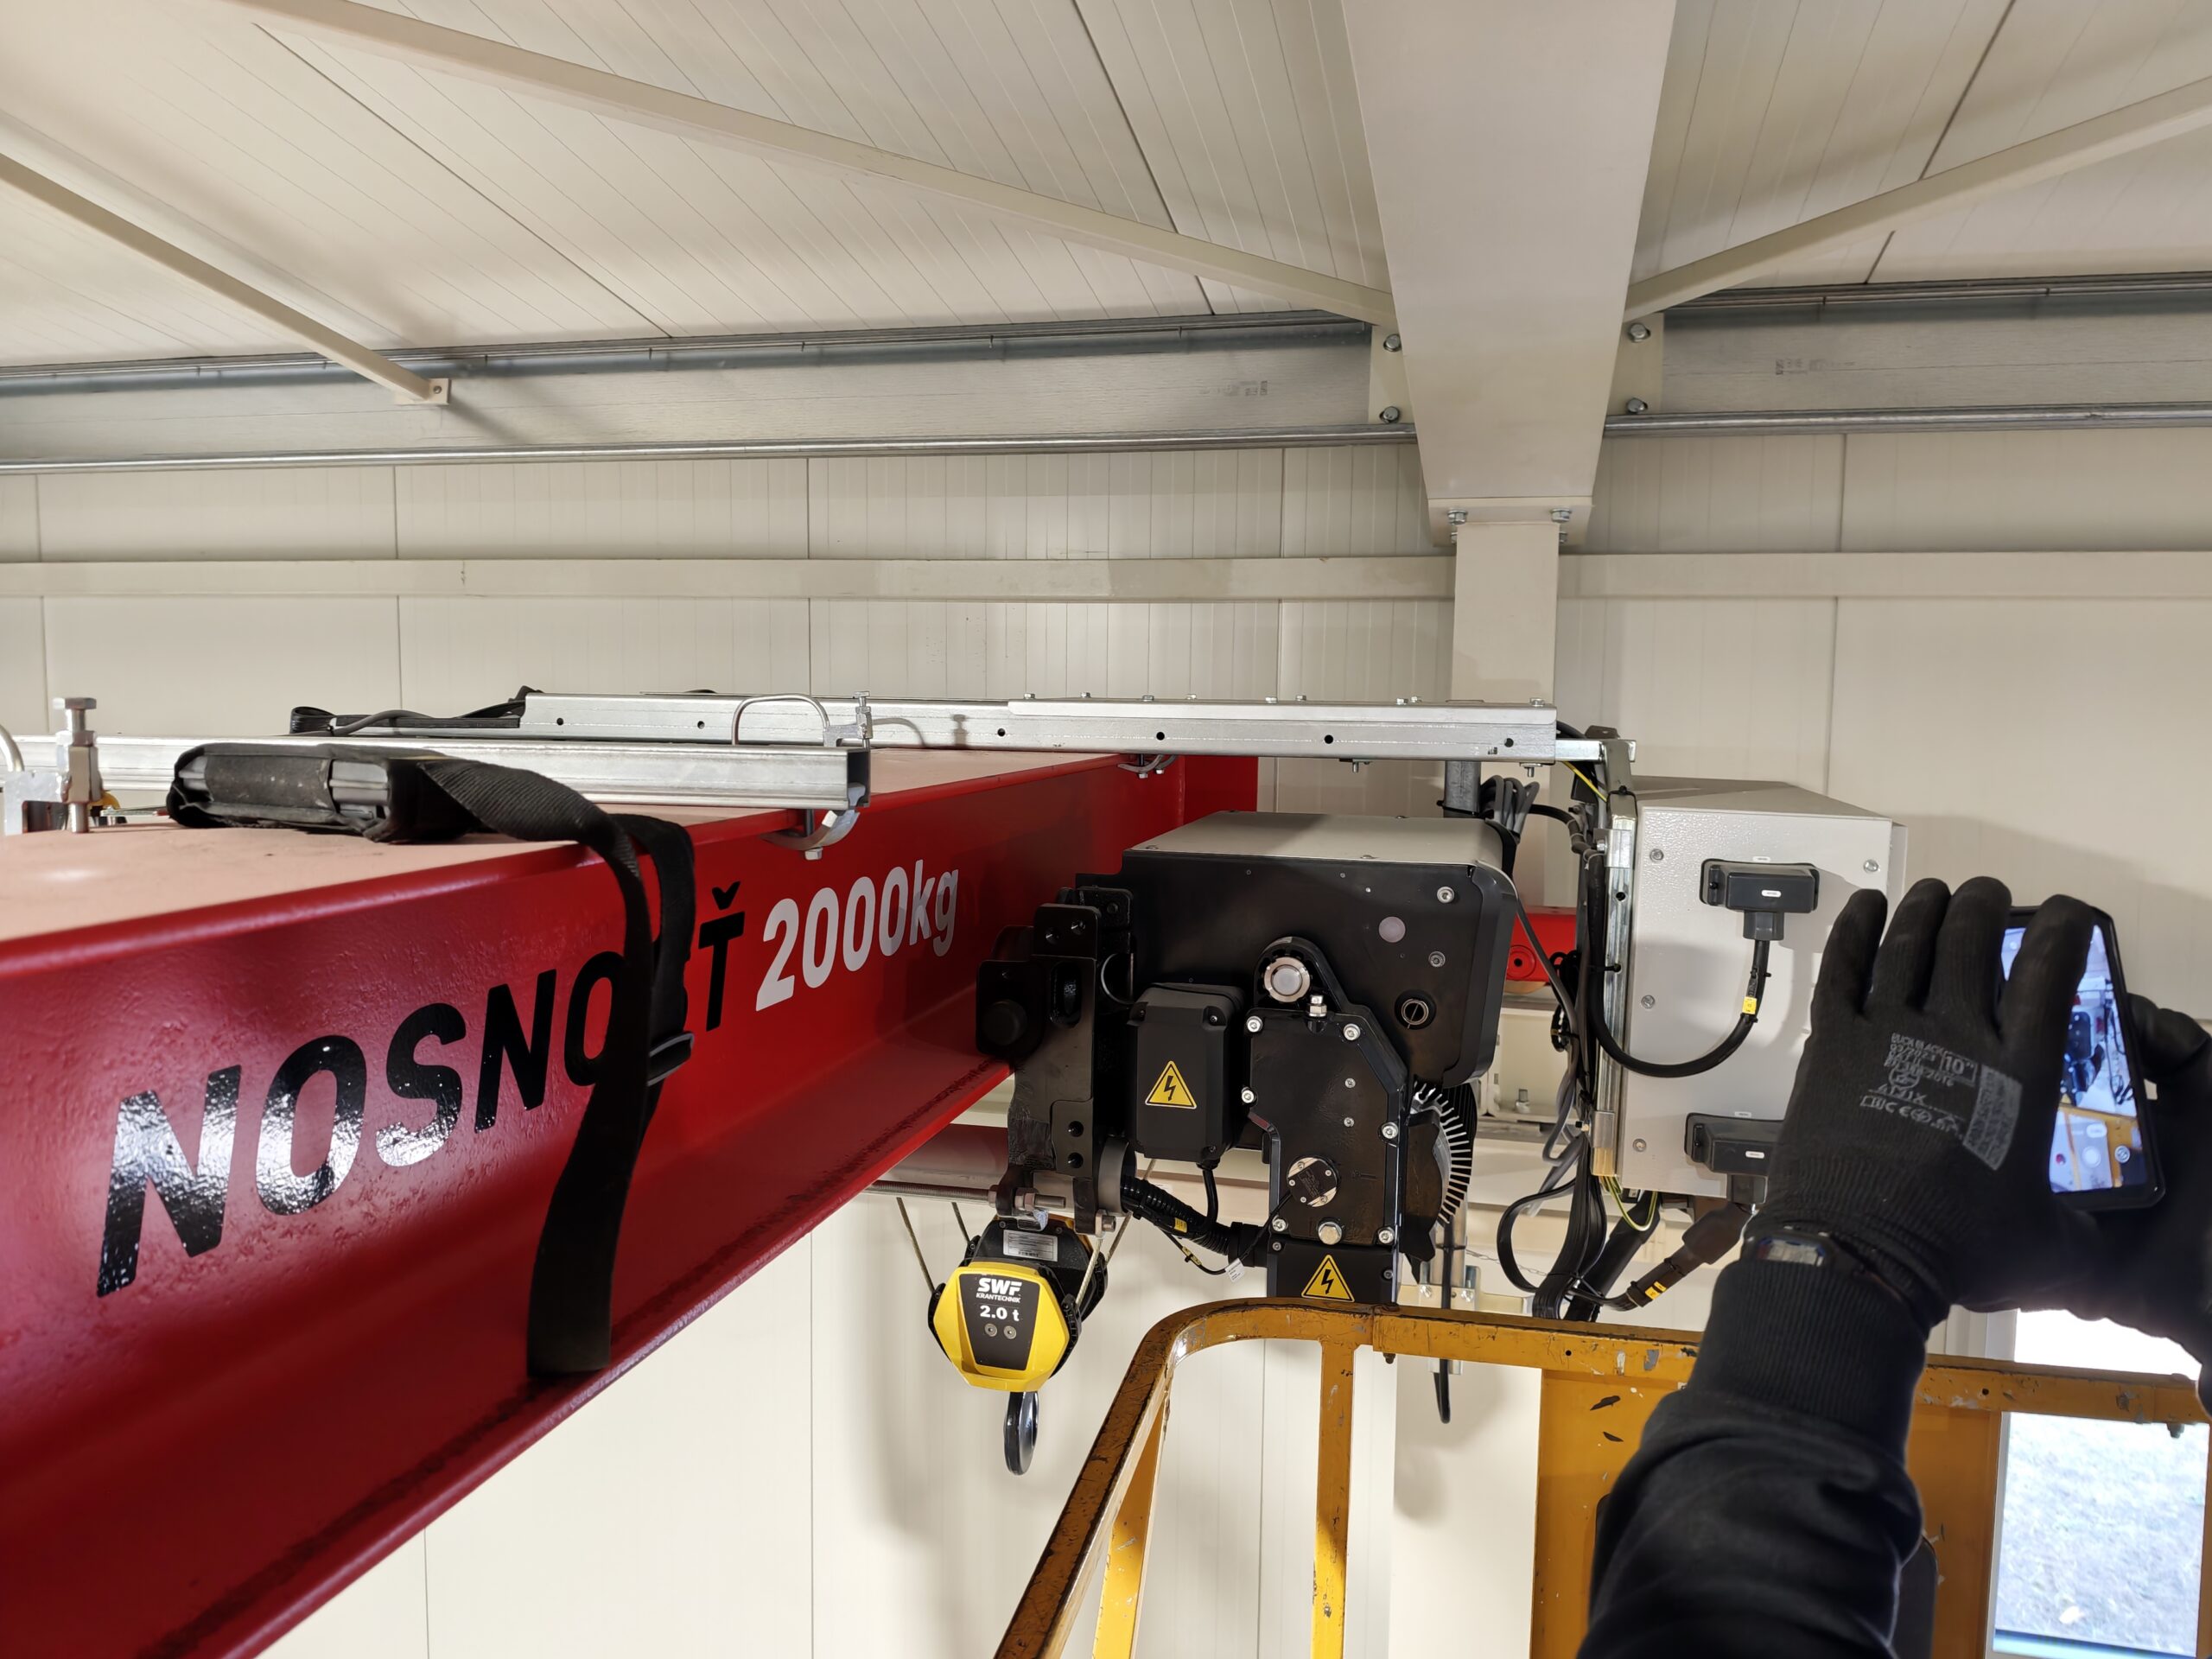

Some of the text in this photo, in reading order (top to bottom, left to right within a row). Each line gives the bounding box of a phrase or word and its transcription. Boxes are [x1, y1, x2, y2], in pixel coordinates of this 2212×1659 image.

[97, 859, 959, 1298] NOSNOŤ 2000kg
[977, 1277, 1022, 1296] SWF
[976, 1292, 1021, 1304] KRANTECHNIK
[980, 1305, 1020, 1322] 2.0 t
